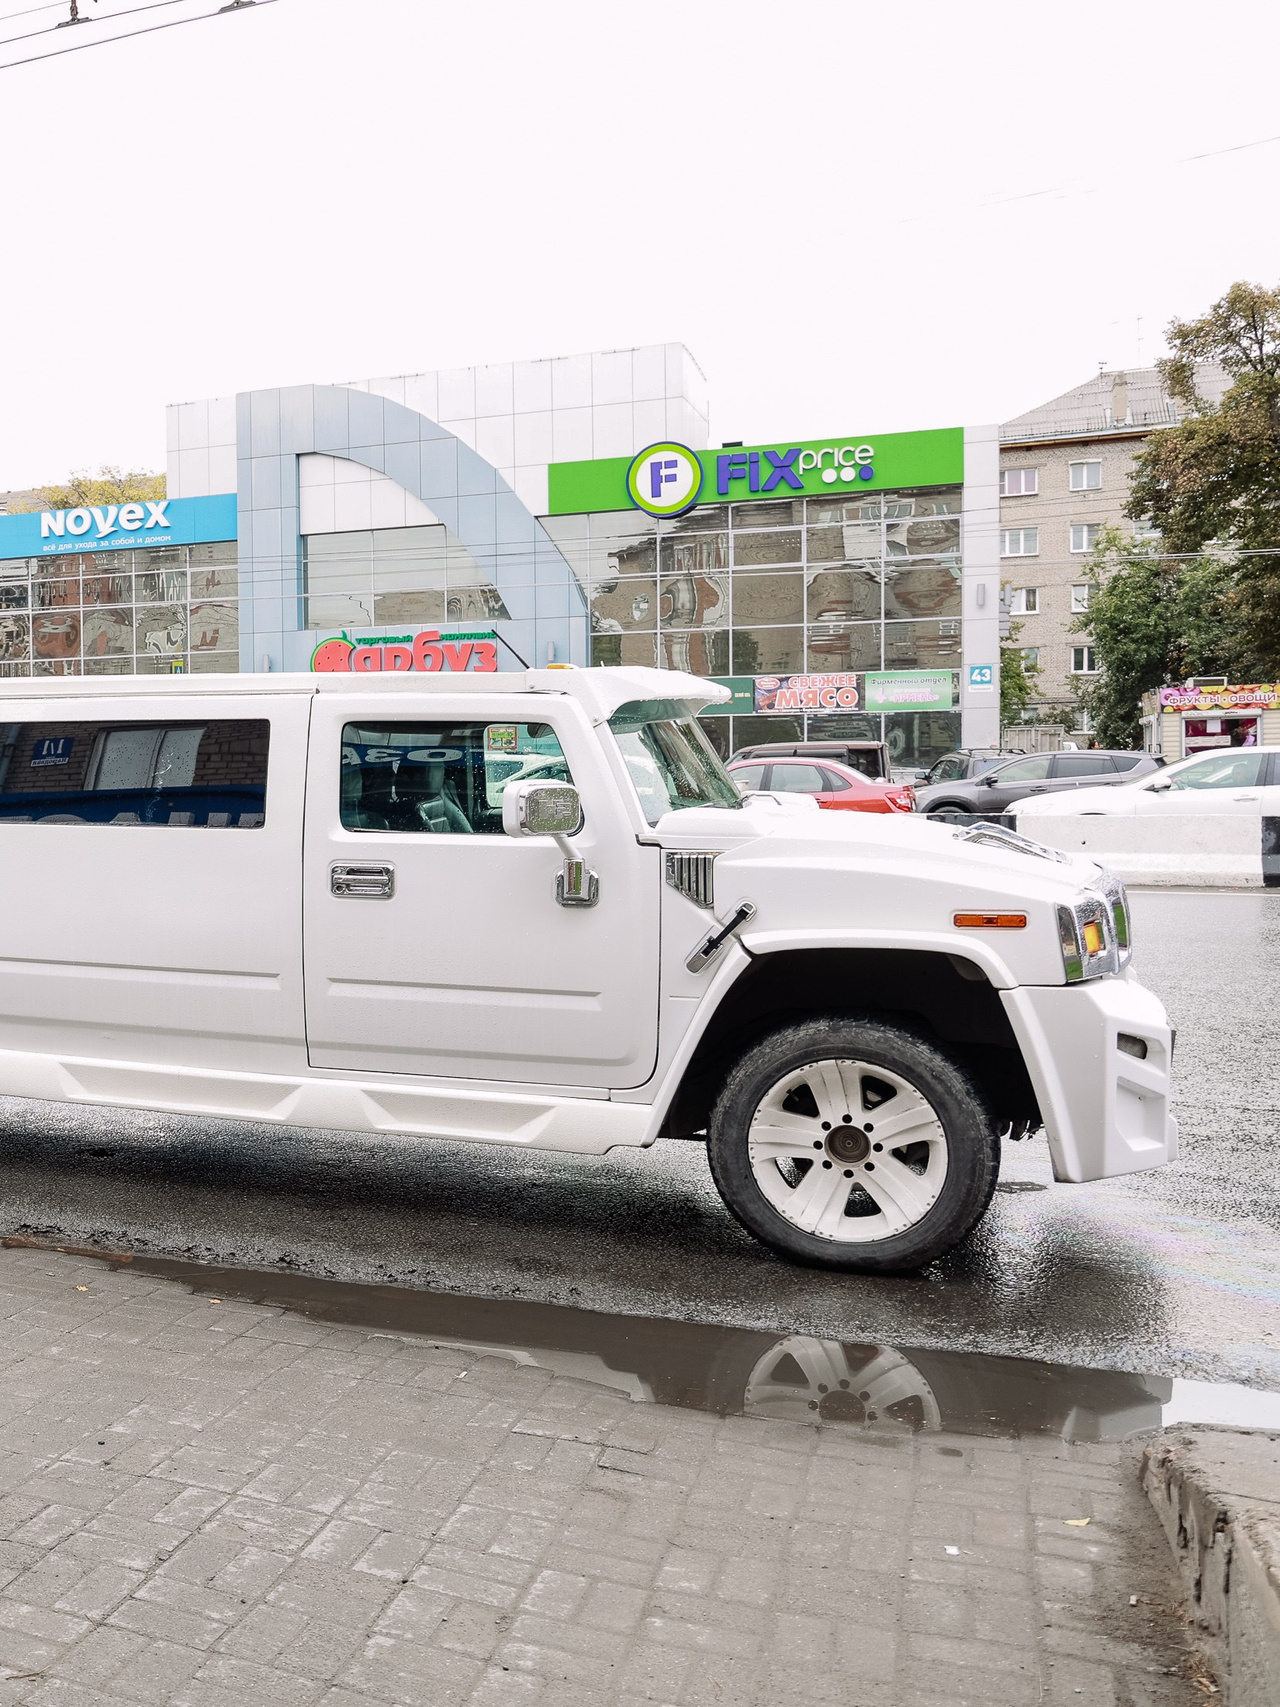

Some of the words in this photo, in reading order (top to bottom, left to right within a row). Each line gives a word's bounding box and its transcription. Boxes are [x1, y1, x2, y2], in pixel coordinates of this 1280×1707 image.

[799, 444, 874, 475] price
[58, 543, 73, 551] для
[74, 541, 97, 551] ухода
[111, 536, 135, 546] собой
[144, 535, 171, 545] домом
[355, 635, 413, 647] торговый
[788, 674, 857, 689] СВЕЖЕЕ
[920, 677, 947, 685] отдел
[971, 668, 991, 682] 43
[775, 687, 859, 709] МЯСО
[1169, 694, 1220, 705] ФРУКТЫ
[1229, 693, 1276, 703] ОВОЩИ
